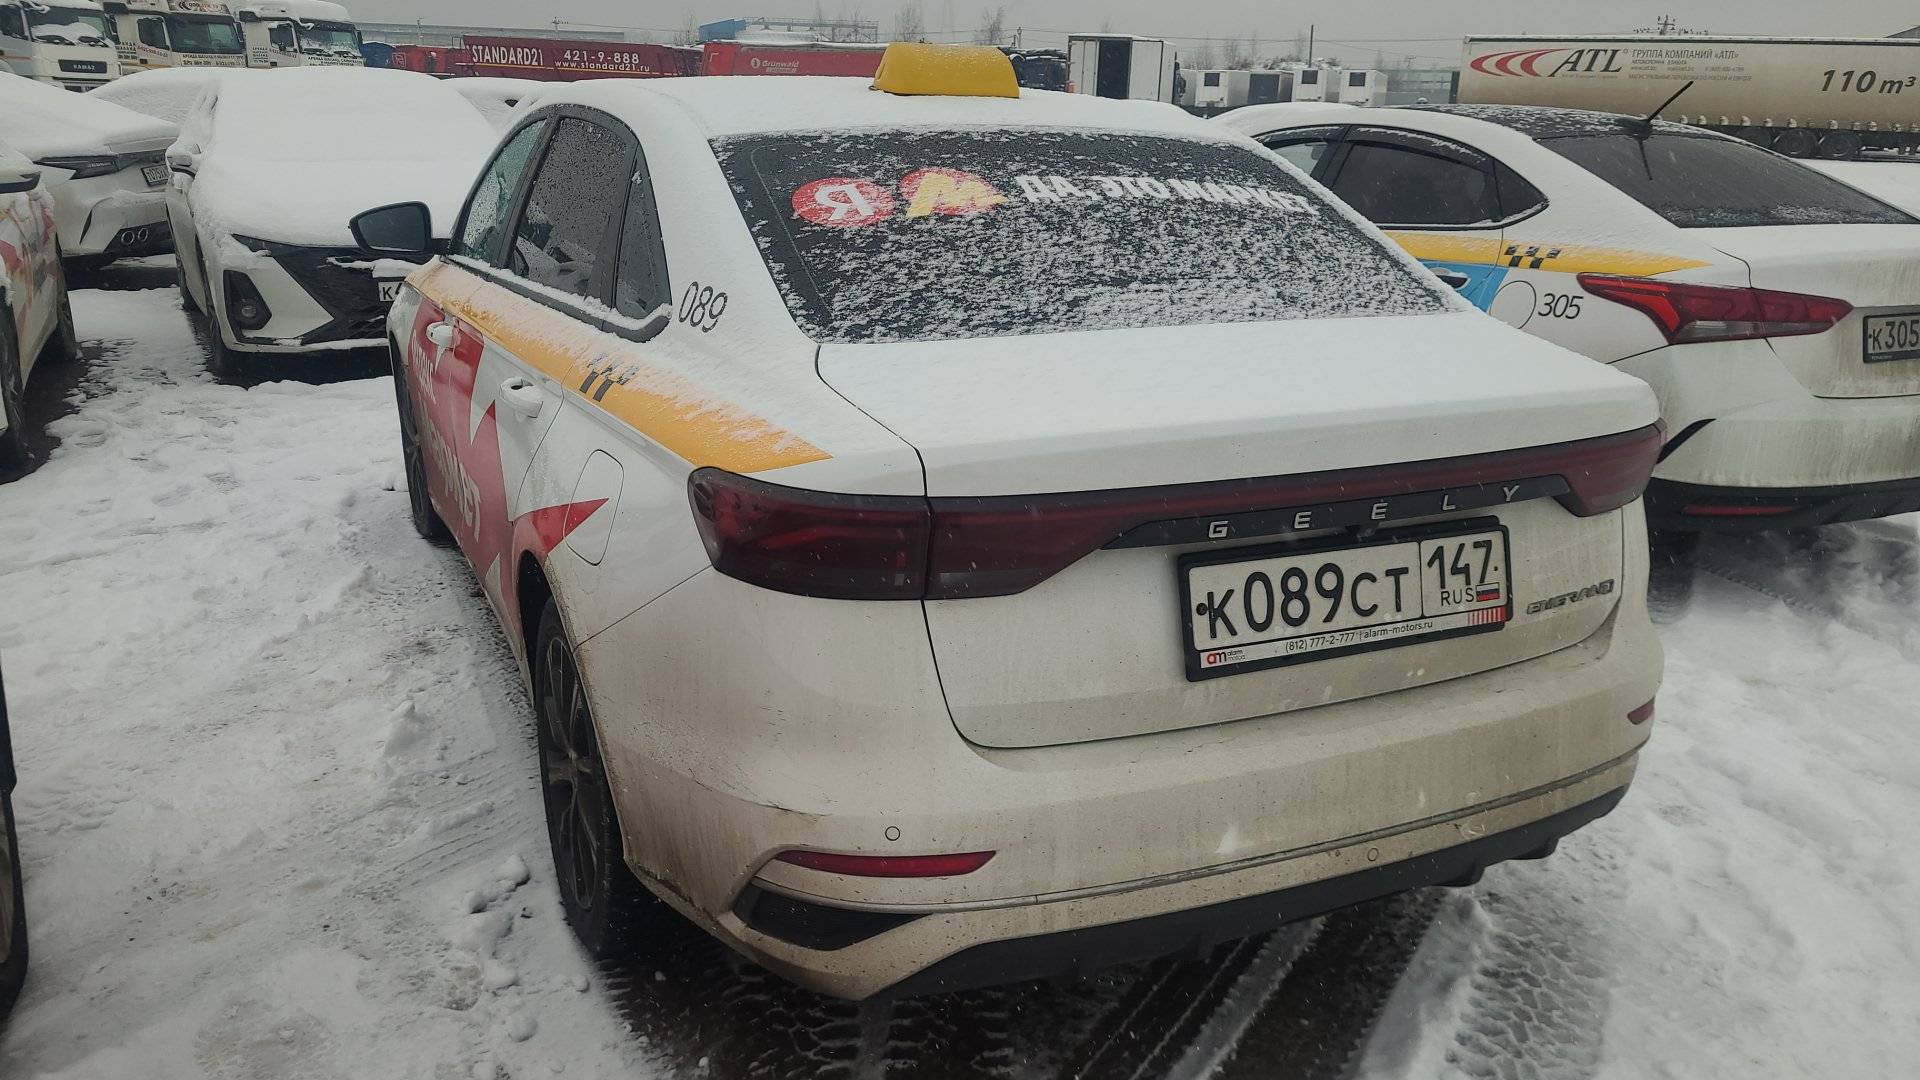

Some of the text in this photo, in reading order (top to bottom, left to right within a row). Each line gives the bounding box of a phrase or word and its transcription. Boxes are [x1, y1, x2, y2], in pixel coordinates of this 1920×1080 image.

[472, 45, 544, 66] STANDARD21
[555, 60, 650, 72] www.standard21.ru
[563, 50, 640, 64] 421-9-888
[1547, 48, 1623, 78] ATL
[1631, 49, 1663, 59] ГРУППА
[1664, 48, 1713, 59] КОМПАНИЙ
[1821, 69, 1877, 93] 110
[1014, 175, 1098, 201] ДА,
[814, 183, 874, 221] Я
[678, 281, 729, 334] 089
[1538, 292, 1584, 320] 305
[1207, 485, 1520, 539] GEELY
[1426, 539, 1493, 590] 147
[1440, 587, 1475, 607] RUS
[1285, 621, 1434, 653] (812) 777-2-777 alarm-motors.ru
